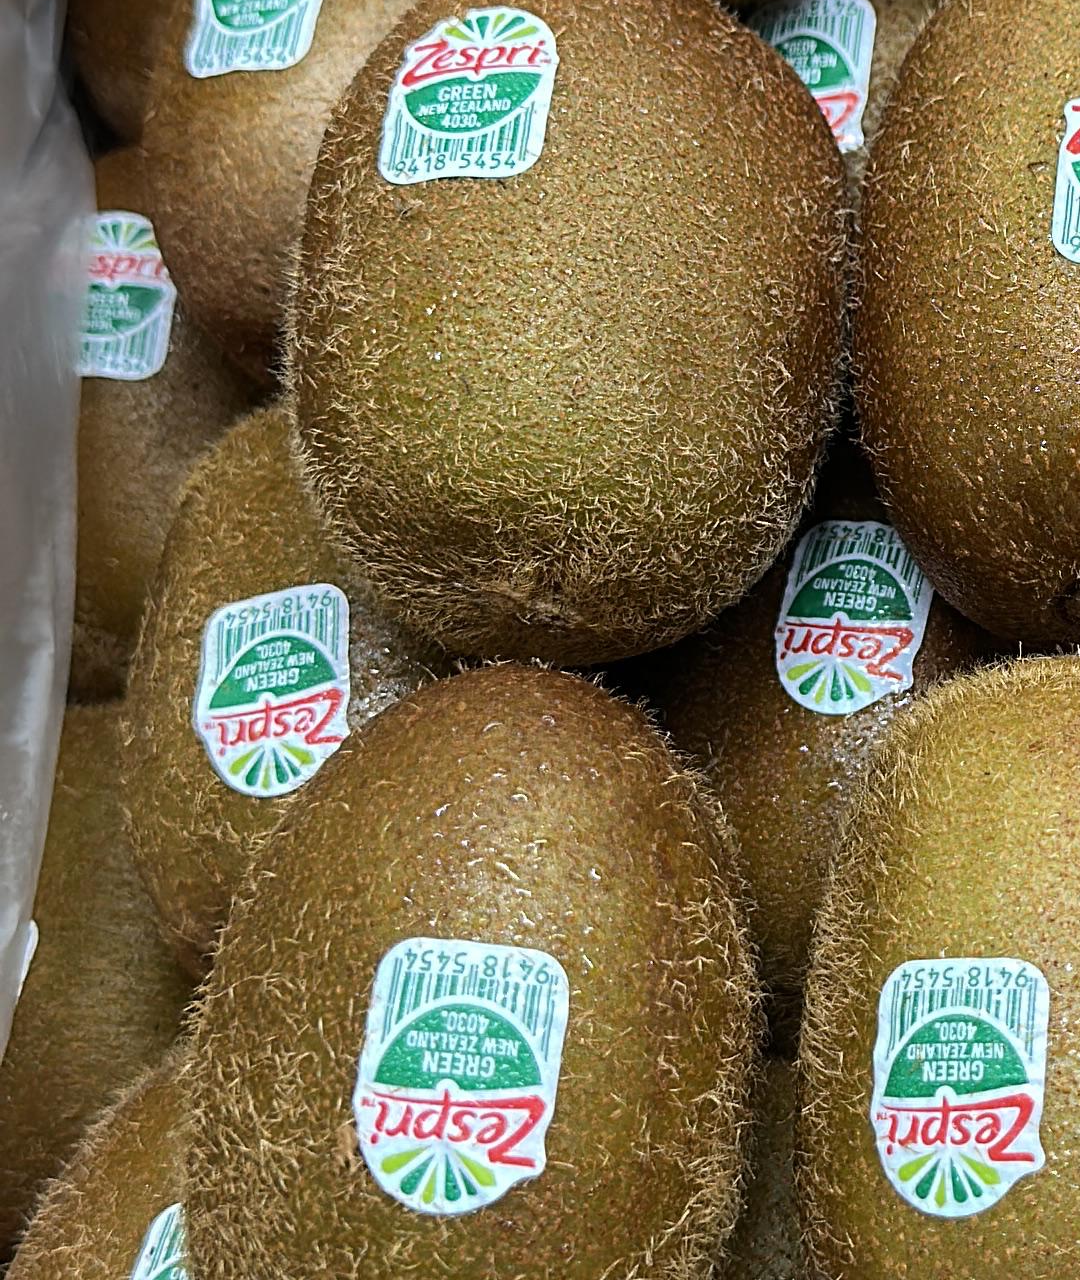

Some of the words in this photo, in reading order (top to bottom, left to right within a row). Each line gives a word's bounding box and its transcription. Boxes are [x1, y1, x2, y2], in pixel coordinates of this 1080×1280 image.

[402, 39, 546, 87] Zespri
[438, 83, 499, 102] GREEN
[417, 101, 450, 117] NEW
[451, 98, 513, 114] ZEALAND
[395, 154, 446, 178] 9418
[459, 152, 516, 171] 5454
[813, 578, 867, 592] ZEALAND
[866, 581, 897, 599] NEW
[282, 591, 332, 614] 9418
[824, 593, 878, 611] GREEN
[226, 602, 271, 628] 5454
[289, 652, 315, 667] NEW
[780, 618, 915, 681] Zespri
[234, 659, 288, 680] ZEALAND
[247, 669, 300, 693] GREEN
[212, 688, 345, 756] Zespri
[405, 948, 468, 973] 5454
[483, 955, 549, 985] 9418
[902, 967, 954, 990] 5454
[968, 967, 1029, 989] 9418
[406, 1030, 479, 1051] ZEALAND
[484, 1036, 521, 1058] NEW
[907, 1042, 971, 1061] ZEALAND
[970, 1042, 1005, 1060] NEW
[422, 1050, 497, 1078] GREEN
[922, 1060, 985, 1082] GREEN
[372, 1087, 546, 1169] Zespri
[881, 1092, 1035, 1162] Zespri
